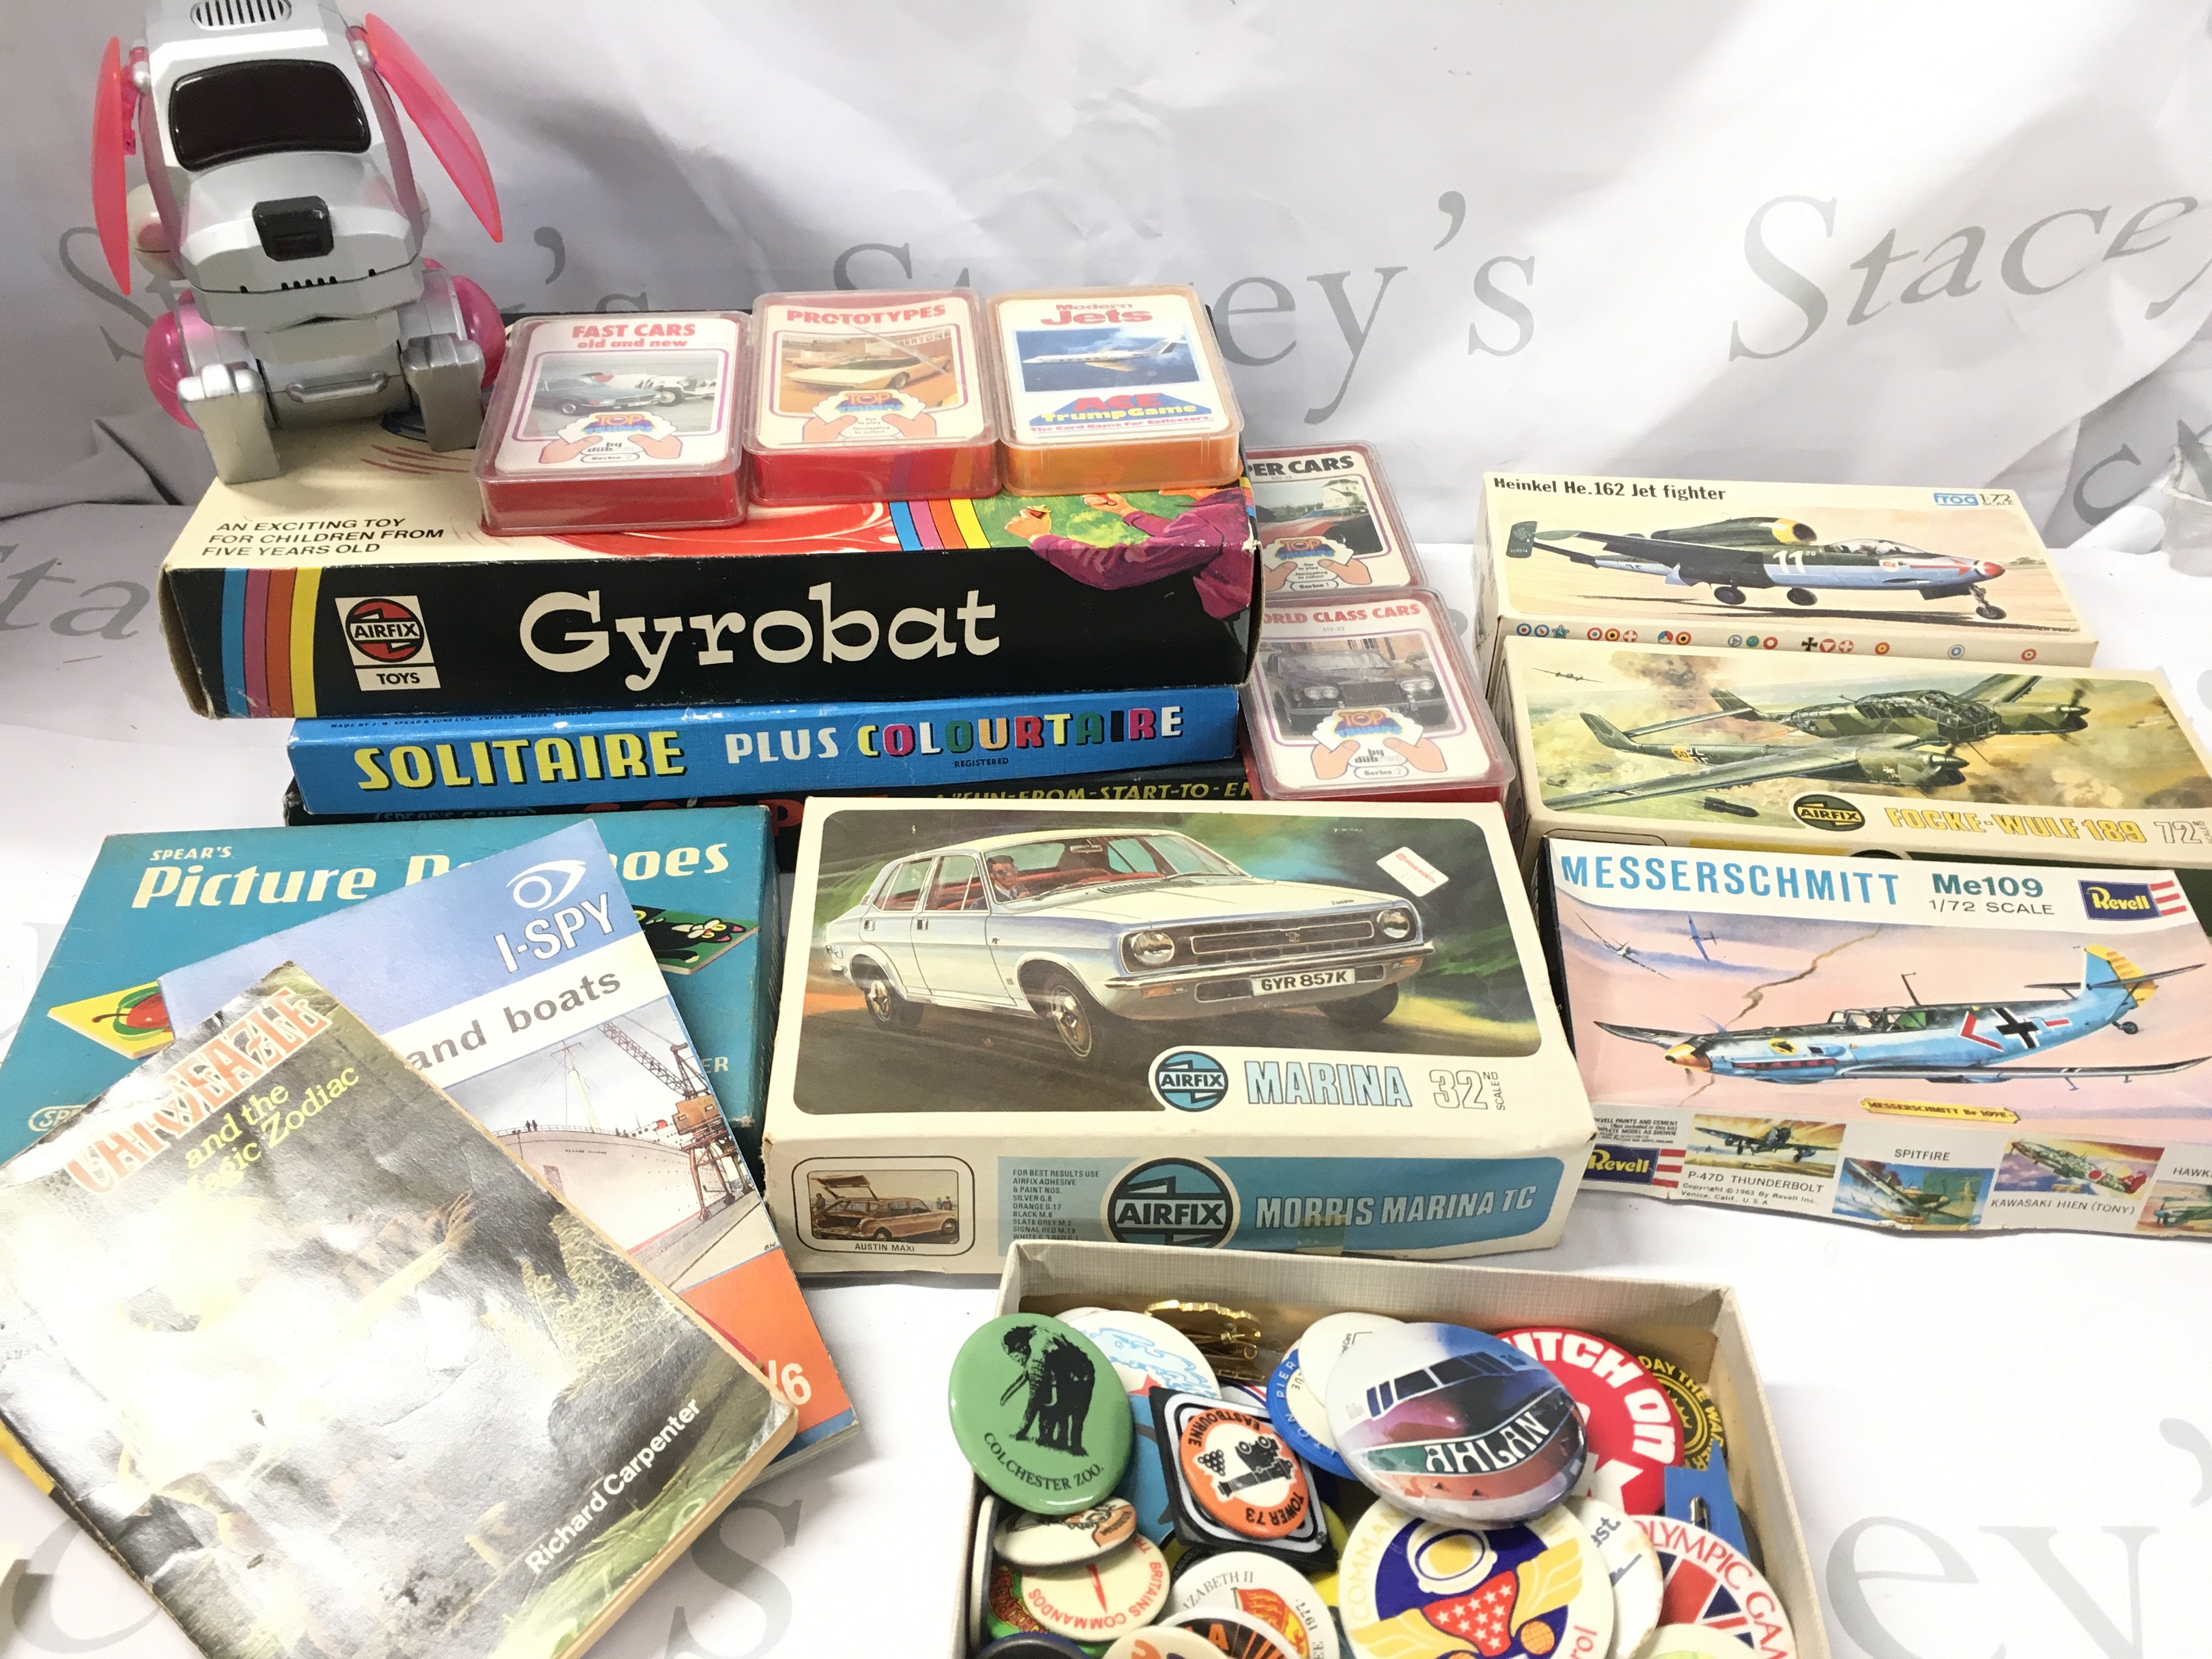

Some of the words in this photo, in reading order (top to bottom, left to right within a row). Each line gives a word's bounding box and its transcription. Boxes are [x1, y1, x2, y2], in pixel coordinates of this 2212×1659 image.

[1728, 193, 2212, 363] Stace
[787, 304, 946, 324] PROTOTYPES
[1041, 308, 1153, 325] Jets
[572, 325, 634, 338] FAST
[639, 323, 696, 337] CARS
[577, 338, 609, 349] old
[612, 338, 645, 348] and
[650, 339, 687, 348] new
[845, 392, 893, 405] TOP
[1073, 392, 1166, 413] ACE
[595, 414, 645, 427] TOP
[1041, 404, 1198, 422] TrumpGame
[1288, 455, 1355, 473] CARS
[1494, 477, 1557, 493] Heinkel
[1565, 481, 1626, 496] He.162
[1632, 483, 1657, 498] Jet
[1663, 484, 1726, 501] fighter
[217, 522, 248, 532] AN
[253, 519, 358, 532] EXCITING
[363, 517, 407, 528] TOY
[209, 534, 253, 544] FOR
[259, 531, 377, 543] CHILDREN
[380, 528, 445, 539] FROM
[1279, 538, 1323, 552] TOP
[202, 545, 251, 556] FIVE
[257, 544, 331, 556] YEARS
[335, 543, 381, 554] OLD
[1263, 612, 1308, 625] ORLD
[1313, 609, 1368, 623] CLASS
[1372, 603, 1421, 619] CARS
[354, 623, 421, 639] AIRFIX
[519, 582, 1001, 692] Gyrobat
[376, 672, 421, 685] TOYS
[1338, 710, 1387, 728] TOP
[354, 730, 687, 791] SOLITAIRE
[725, 727, 839, 765] PLUS
[857, 706, 1184, 758] COLOURTAIRE
[1367, 748, 1385, 757] by
[955, 757, 1009, 768] REGISTERED
[1798, 808, 1864, 824] AIRFIX
[1884, 808, 2079, 839] FOCKE-WULF
[2082, 820, 2148, 843] 189
[2153, 821, 2203, 844] 72
[150, 846, 232, 861] SPEAR'S
[132, 865, 377, 909] Picture
[405, 843, 729, 888] Does
[1561, 855, 1900, 905] MESSERSCHMITT
[1932, 873, 2044, 898] Me109
[1928, 900, 1976, 913] 1/72
[1987, 901, 2056, 915] SCALE
[2085, 886, 2150, 911] Revell
[494, 892, 614, 973] I-SPY
[1261, 975, 1296, 992] GYR
[1300, 970, 1348, 987] 857K
[407, 1019, 487, 1072] and
[503, 972, 621, 1034] boats
[1161, 1072, 1224, 1088] AIRFIX
[1244, 1060, 1413, 1107] MARINA
[1429, 1069, 1488, 1110] 32
[1483, 1071, 1499, 1081] ND
[1495, 1080, 1506, 1111] SCALE
[261, 1068, 360, 1149] Zodiac
[184, 1120, 242, 1170] and
[241, 1084, 289, 1127] the
[1587, 1149, 1649, 1172] Revell
[1895, 1148, 1951, 1162] SPITFIRE
[1050, 1170, 1084, 1178] RESULTS
[1688, 1171, 1724, 1183] P-47D
[1731, 1176, 1825, 1194] THUNDERBOLT
[2172, 1167, 2212, 1178] HAWK
[1683, 1182, 1725, 1195] Copyright
[1773, 1192, 1799, 1203] Revell
[1115, 1203, 1225, 1226] AIRFIX
[1255, 1197, 1375, 1229] MORRIS
[1380, 1189, 1494, 1226] MARINA
[1502, 1186, 1537, 1212] TC
[1991, 1198, 2052, 1208] KAWASAKI
[2057, 1200, 2088, 1211] HIEN
[2091, 1201, 2136, 1216] (TONY)
[854, 1243, 888, 1251] AUSTIN
[891, 1243, 915, 1252] MAXI
[1502, 1331, 1645, 1389] ITCH
[1276, 1361, 1297, 1399] PIER
[1679, 1369, 1707, 1403] THE
[1188, 1409, 1261, 1448] EASTBOURNE
[1426, 1410, 1550, 1473] AHLAN
[984, 1431, 1073, 1491] COLCHESTER
[524, 1491, 608, 1576] Richard
[603, 1398, 702, 1497] Carpenter
[1245, 1507, 1266, 1526] 73
[1269, 1491, 1305, 1527] TOWER
[1132, 1561, 1163, 1617] BRITAINS
[1183, 1571, 1239, 1609] IZABETH
[1244, 1571, 1254, 1583] II
[1634, 1520, 1754, 1591] OLYMPIC
[1746, 1591, 1791, 1659] GAM
[1028, 1588, 1126, 1630] COMMANDOS
